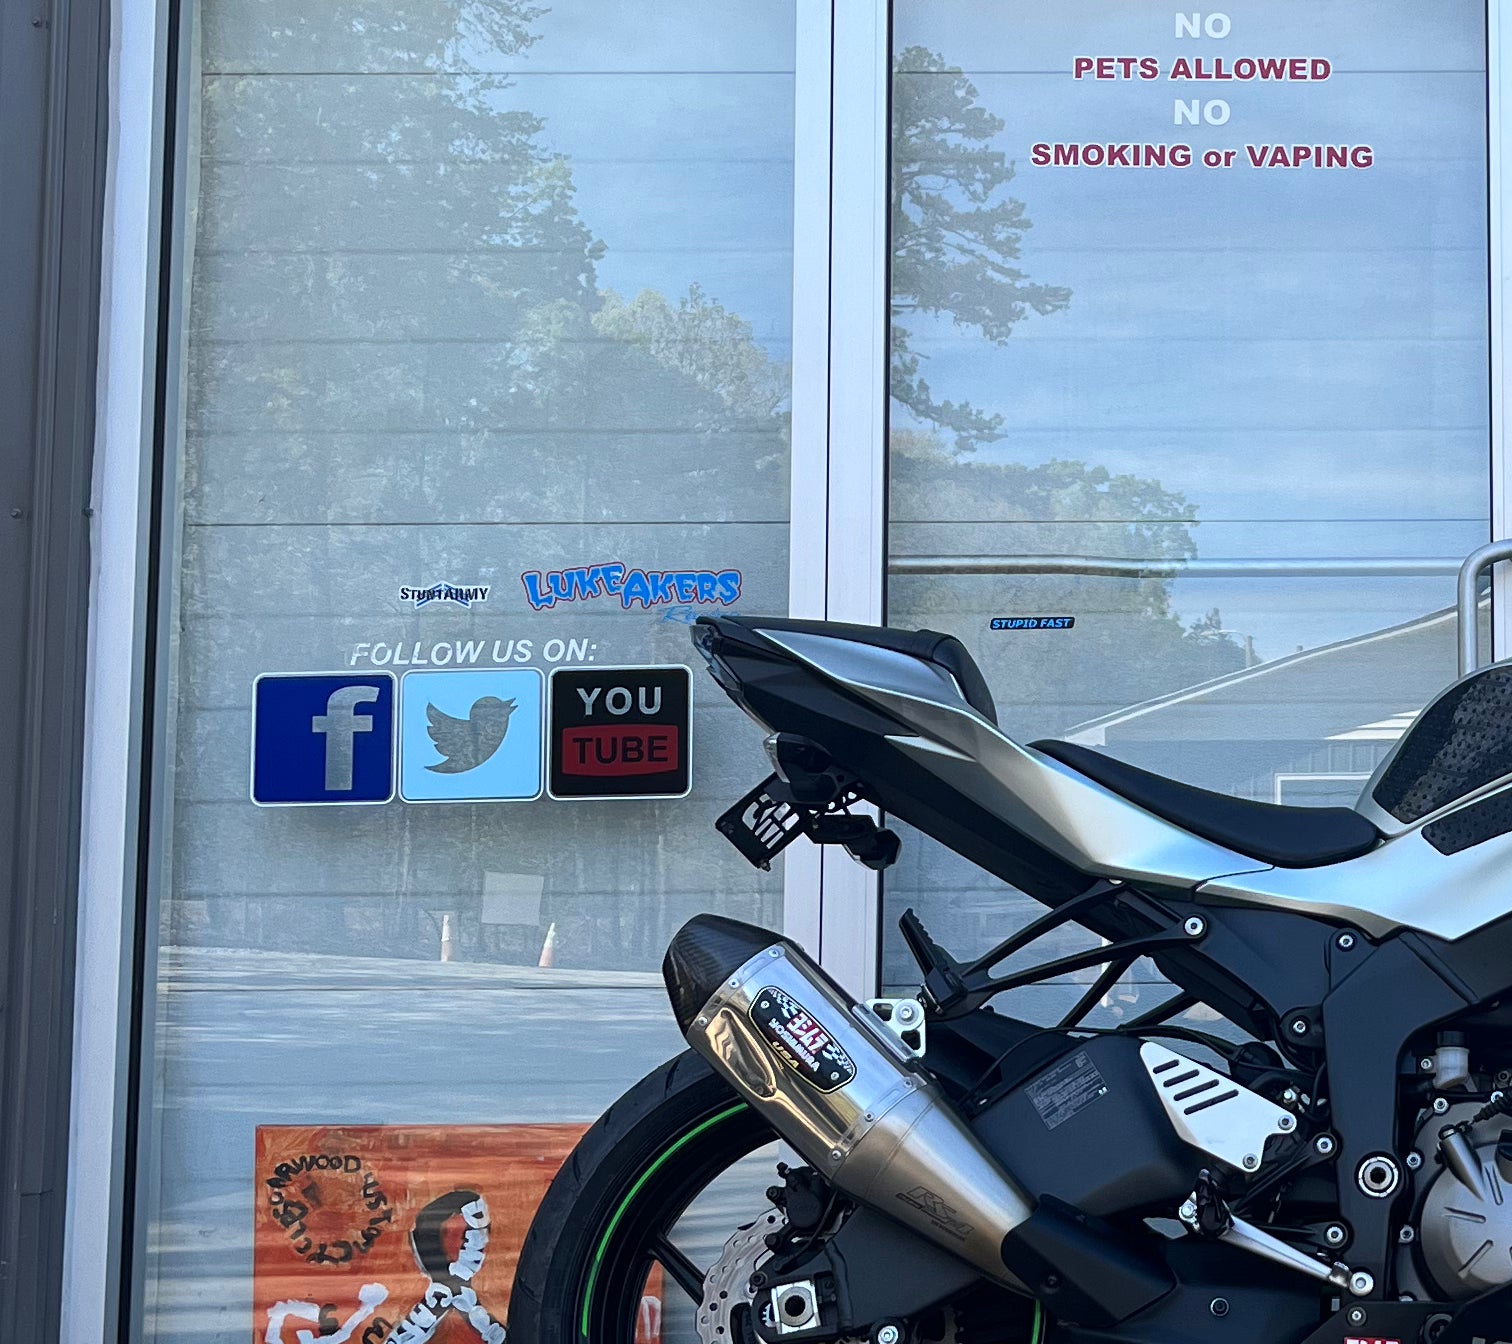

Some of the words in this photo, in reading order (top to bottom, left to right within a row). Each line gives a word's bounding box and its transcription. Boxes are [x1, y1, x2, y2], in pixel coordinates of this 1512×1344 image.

[1174, 12, 1232, 39] NO
[1073, 56, 1159, 81] PETS
[1170, 57, 1332, 81] ALLOWED
[1173, 98, 1231, 125] NO
[1031, 142, 1192, 168] SMOKING
[1204, 147, 1236, 167] or
[1245, 144, 1374, 169] VAPING
[992, 619, 1037, 628] STUPID
[1040, 619, 1071, 628] FAST
[350, 640, 486, 666] FOLLOW
[492, 639, 532, 663] US
[543, 638, 597, 662] ON:
[576, 686, 662, 716] YOU
[572, 735, 669, 765] TUBE
[768, 1018, 820, 1072] YOSHIMURA
[772, 1042, 799, 1068] USA
